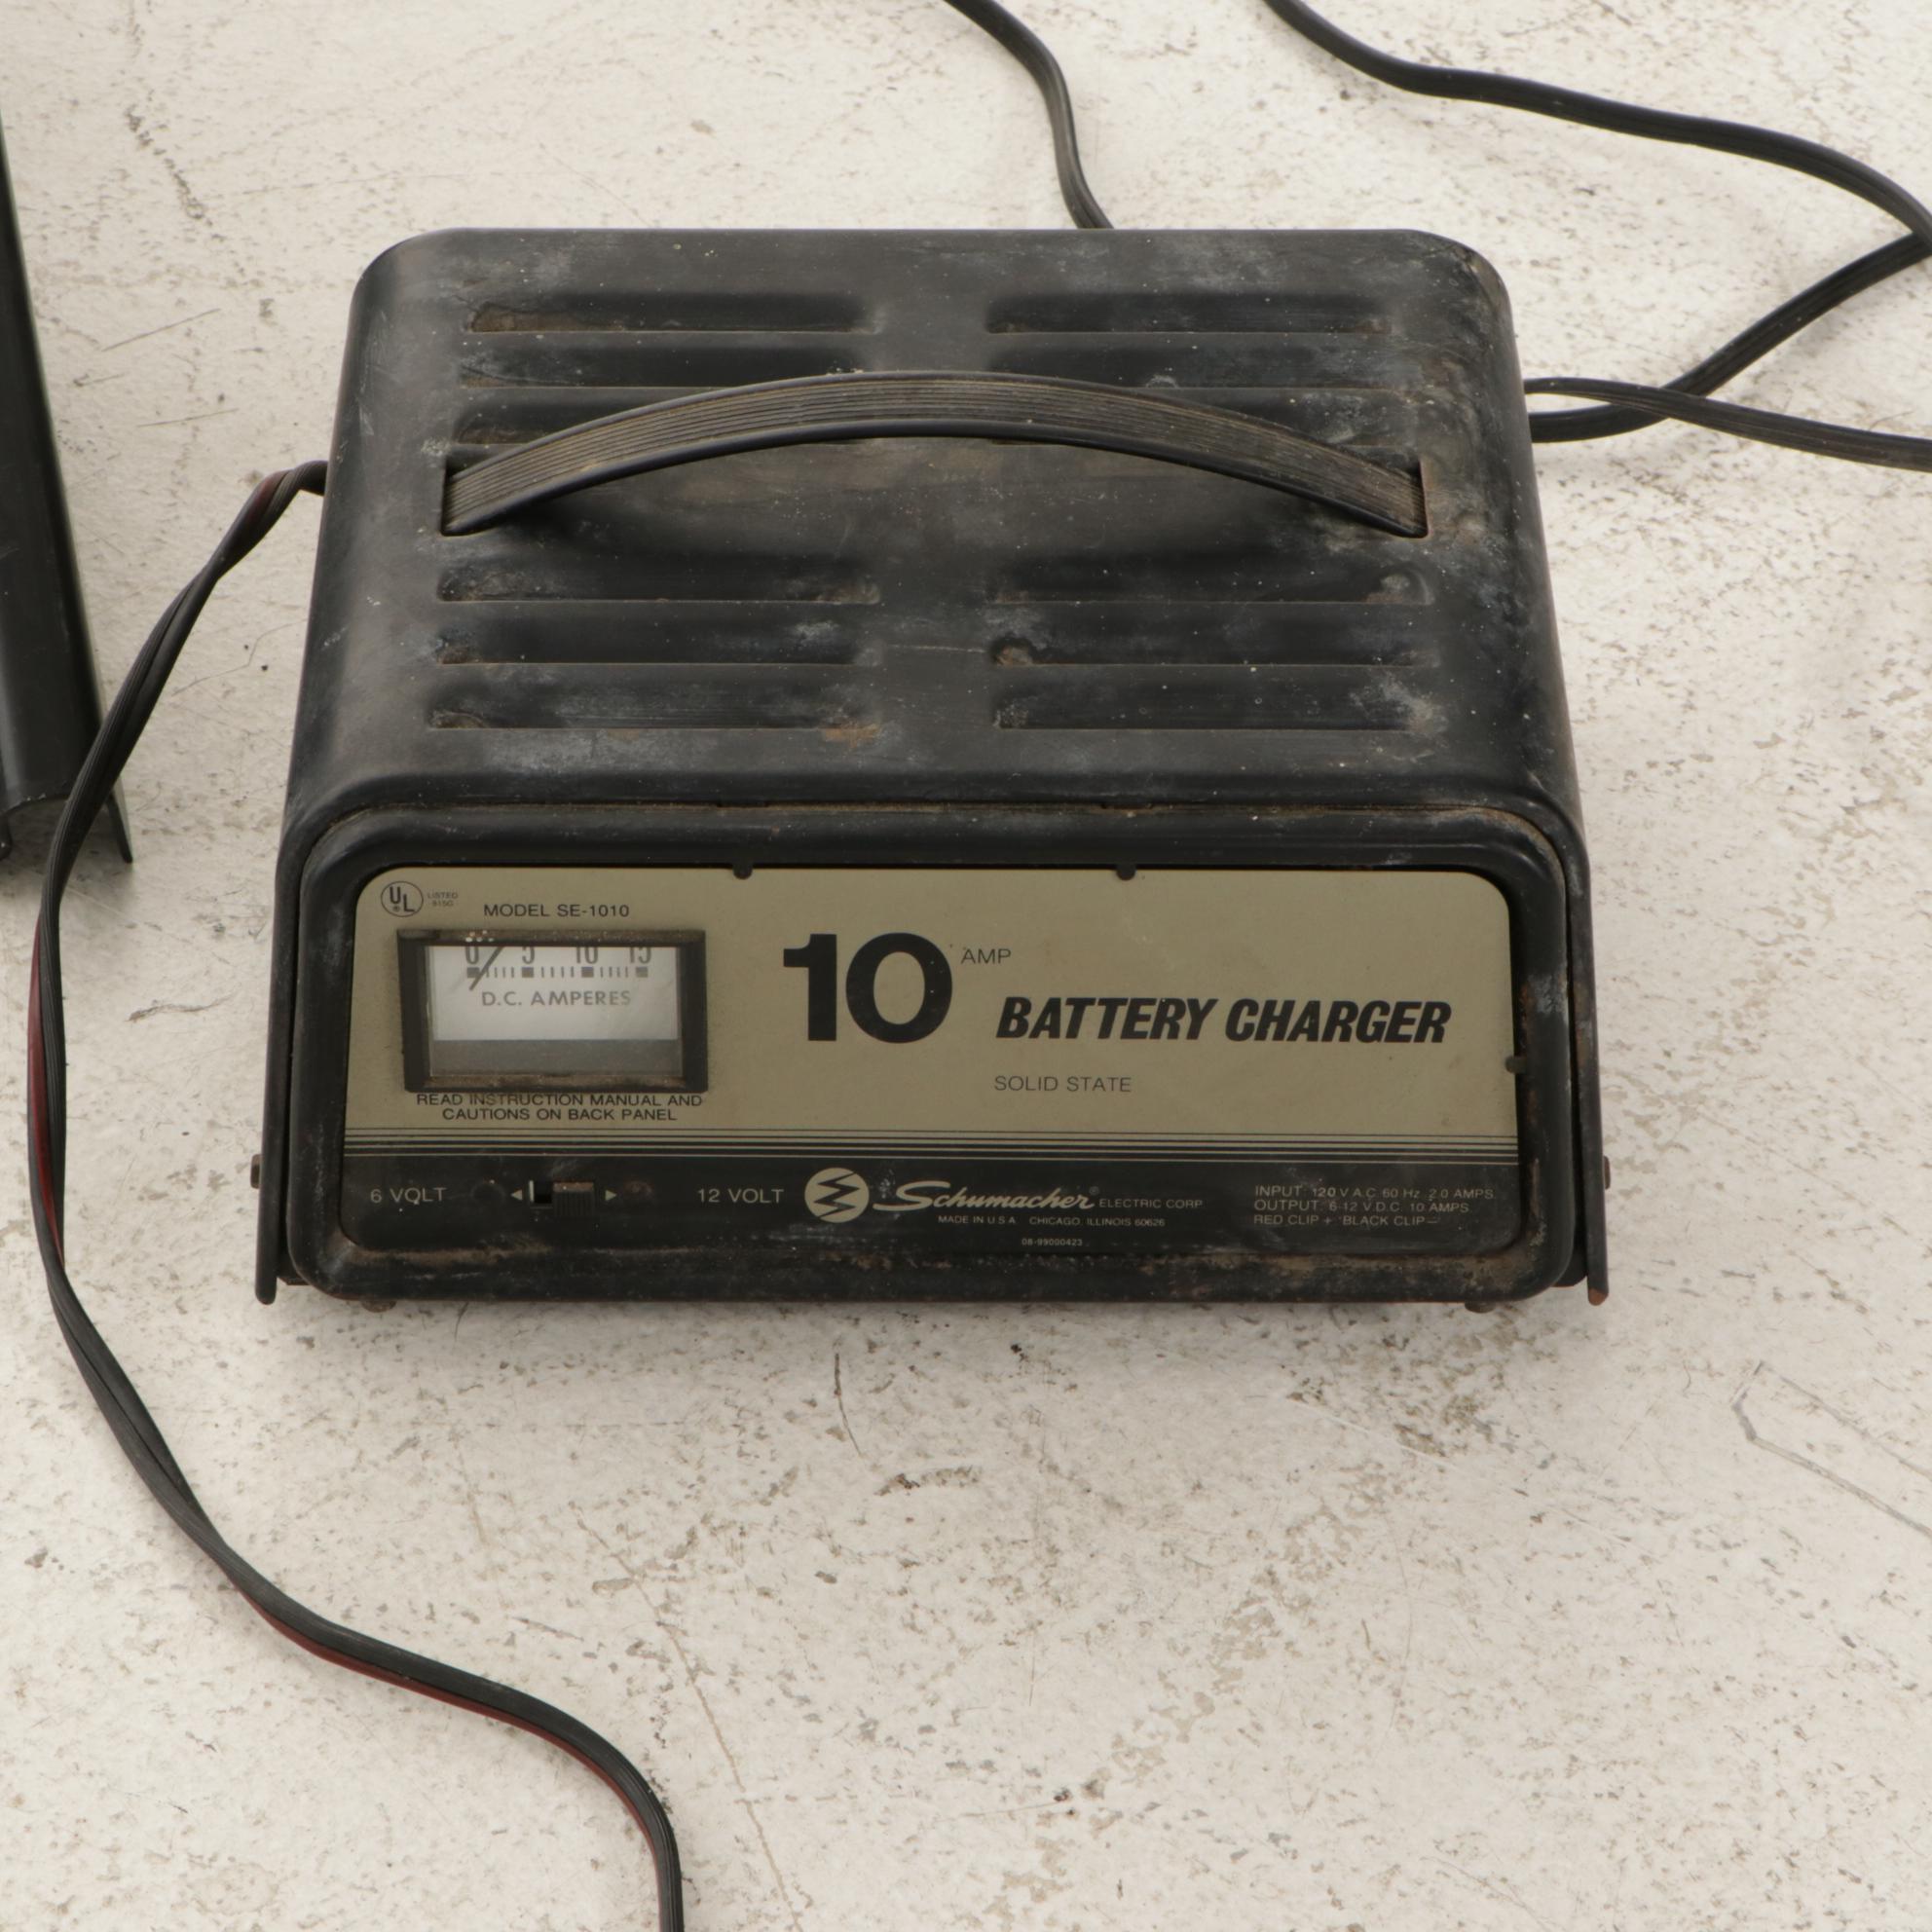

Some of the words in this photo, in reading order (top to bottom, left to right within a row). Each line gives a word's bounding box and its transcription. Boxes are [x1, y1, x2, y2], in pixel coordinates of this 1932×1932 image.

[484, 904, 549, 917] MODEL
[557, 904, 630, 917] SE-1010
[783, 932, 953, 1044] 10
[960, 948, 1012, 965] AMP
[482, 991, 522, 1006] D.C.
[531, 990, 631, 1006] AMPERES
[995, 996, 1219, 1040] BATTERY
[1224, 998, 1452, 1043] CHARGER
[994, 1076, 1059, 1092] SOLID
[1065, 1076, 1132, 1092] STATE
[417, 1094, 463, 1106] READ
[469, 1094, 583, 1106] INSTRUCTION
[590, 1095, 661, 1107] MANUAL
[668, 1095, 702, 1107] AND
[442, 1108, 530, 1121] CAUTIONS
[537, 1108, 562, 1121] ON
[569, 1108, 614, 1121] BACK
[621, 1108, 678, 1121] PANEL
[370, 1189, 383, 1204] 6
[390, 1187, 447, 1204] VOLT
[697, 1189, 720, 1204] 12
[727, 1189, 785, 1204] VOLT
[873, 1180, 1095, 1211] Schumacher
[1099, 1198, 1162, 1208] ELECTRIC
[1382, 1187, 1399, 1199] 60
[1409, 1203, 1426, 1212] 10
[938, 1215, 969, 1224] MADE
[973, 1215, 985, 1224] IN
[1087, 1217, 1132, 1227] ILLINOIS
[1253, 1214, 1283, 1225] RED
[1287, 1214, 1319, 1225] CLIP
[1342, 1215, 1389, 1227] BLACK
